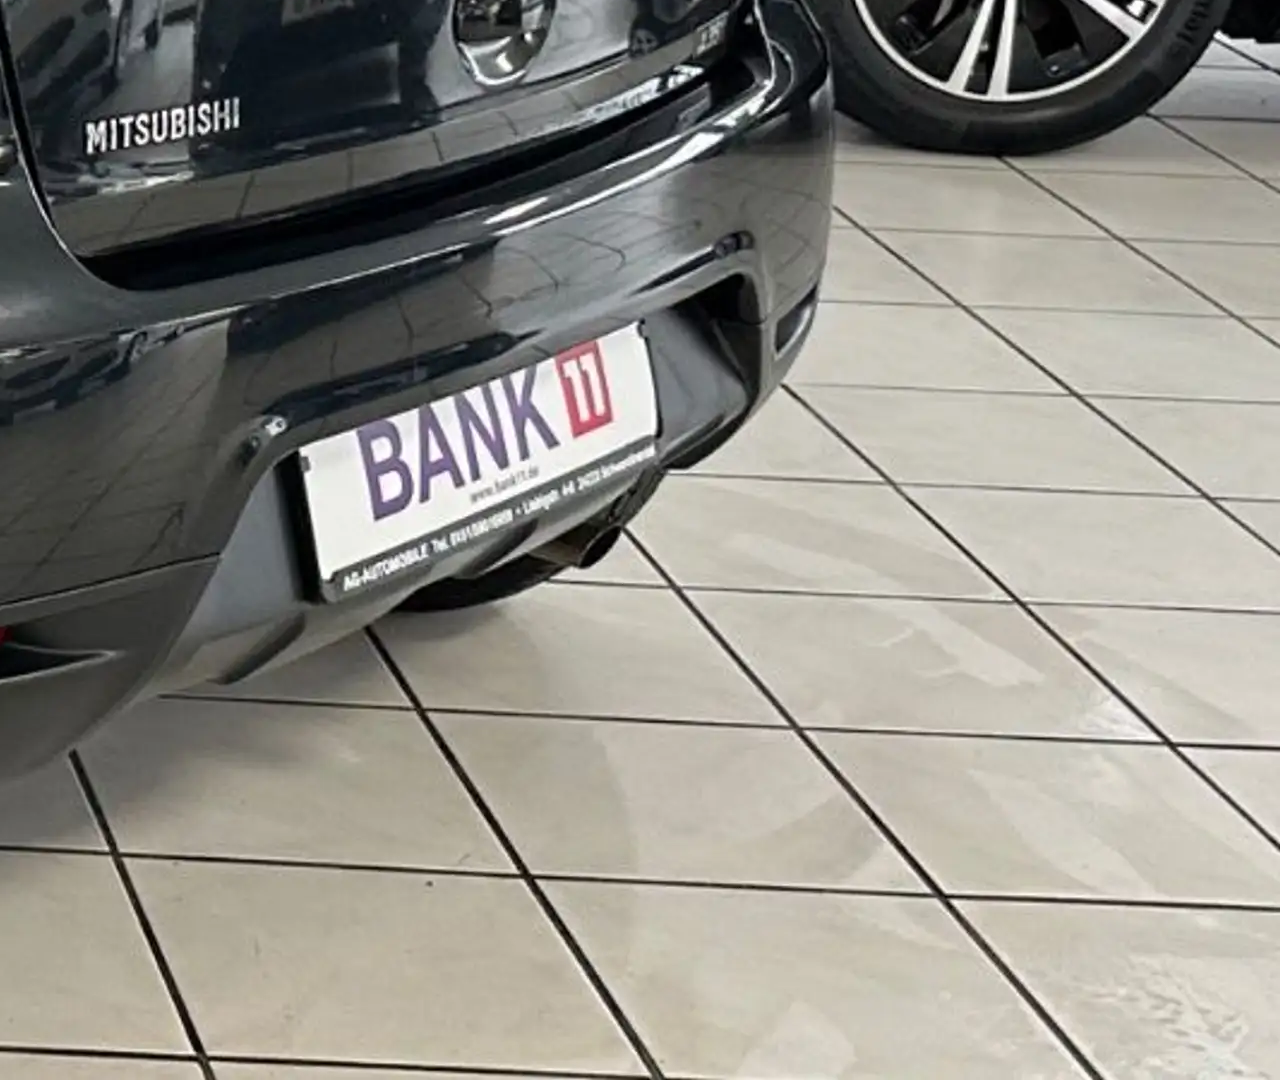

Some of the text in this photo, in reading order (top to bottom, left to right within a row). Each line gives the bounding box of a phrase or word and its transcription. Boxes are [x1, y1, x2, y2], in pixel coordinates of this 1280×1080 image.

[85, 95, 241, 155] MITSUBISHI
[355, 349, 609, 522] BANK 11
